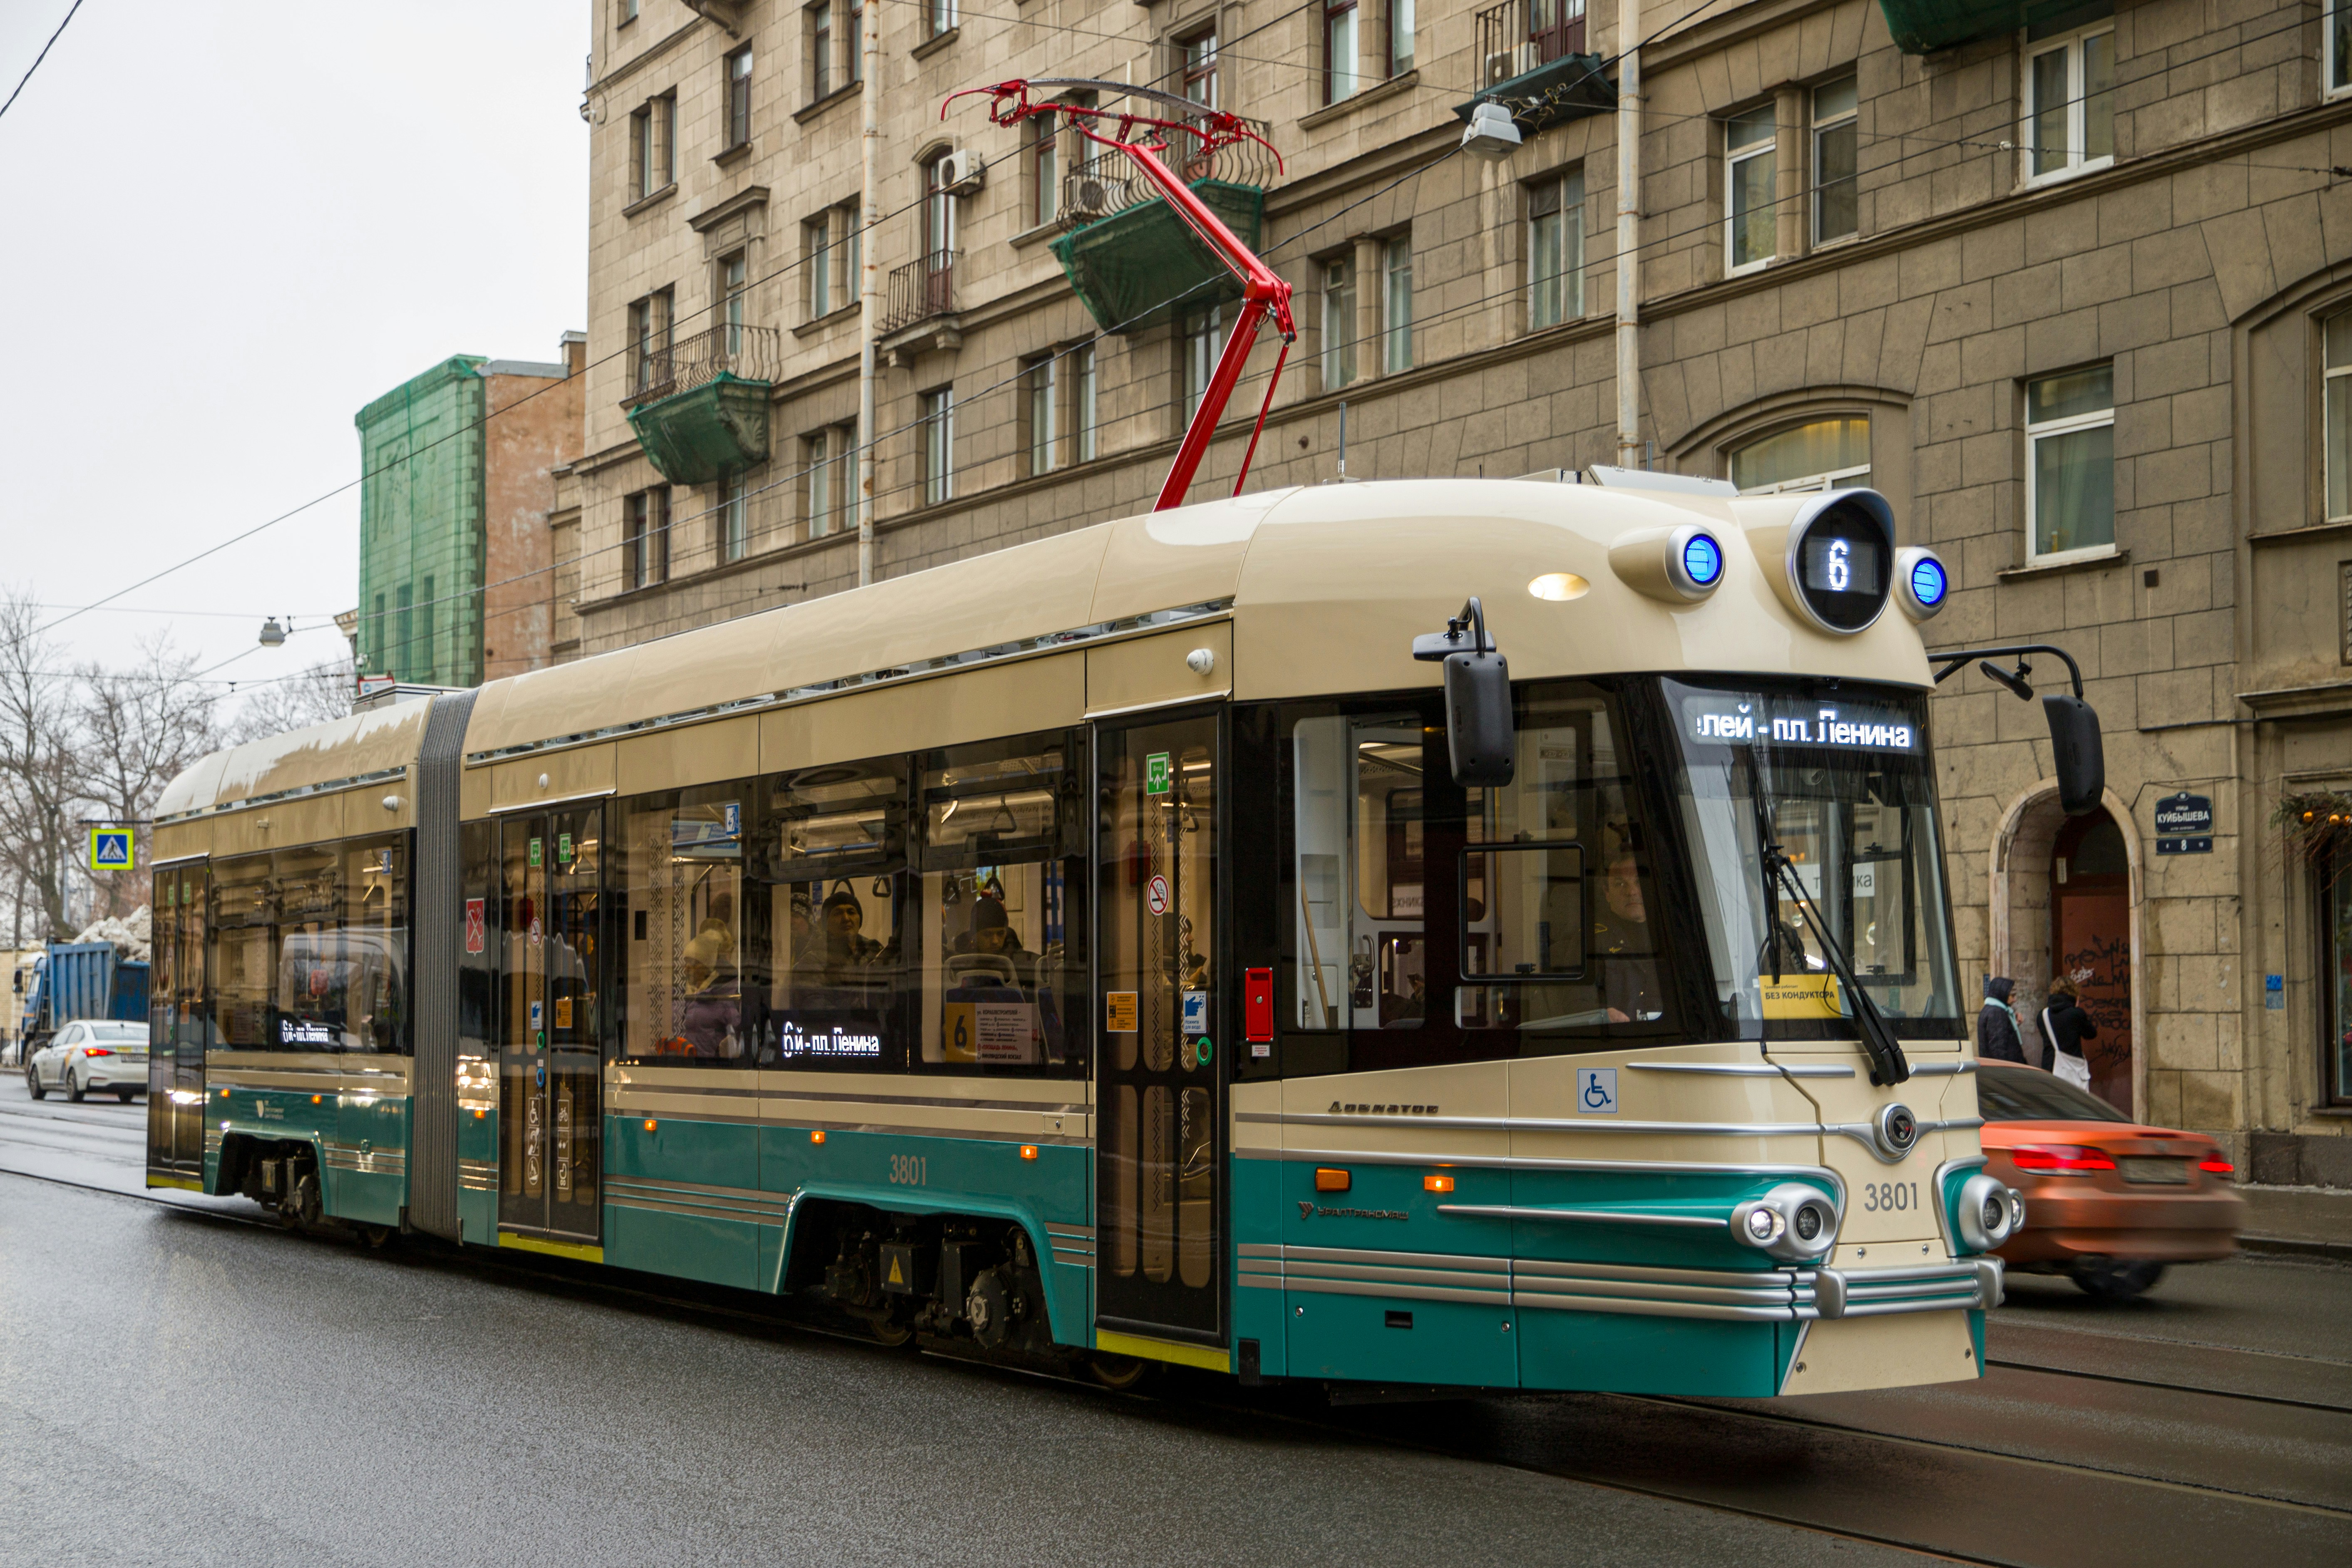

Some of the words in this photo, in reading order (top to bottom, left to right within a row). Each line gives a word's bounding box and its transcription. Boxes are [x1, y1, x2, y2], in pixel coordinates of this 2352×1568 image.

[1829, 541, 1848, 590] 6
[1773, 719, 1811, 742] пл.
[1818, 710, 1910, 747] Ленина
[2157, 810, 2210, 824] КУЙБЫШЕВА
[2181, 839, 2187, 851] 8
[1782, 991, 1835, 1000] КОНДУКТОРА
[832, 1027, 879, 1056] Ленина
[954, 1015, 967, 1049] 6
[889, 1154, 926, 1186] 3801
[1865, 1182, 1917, 1211] 3801
